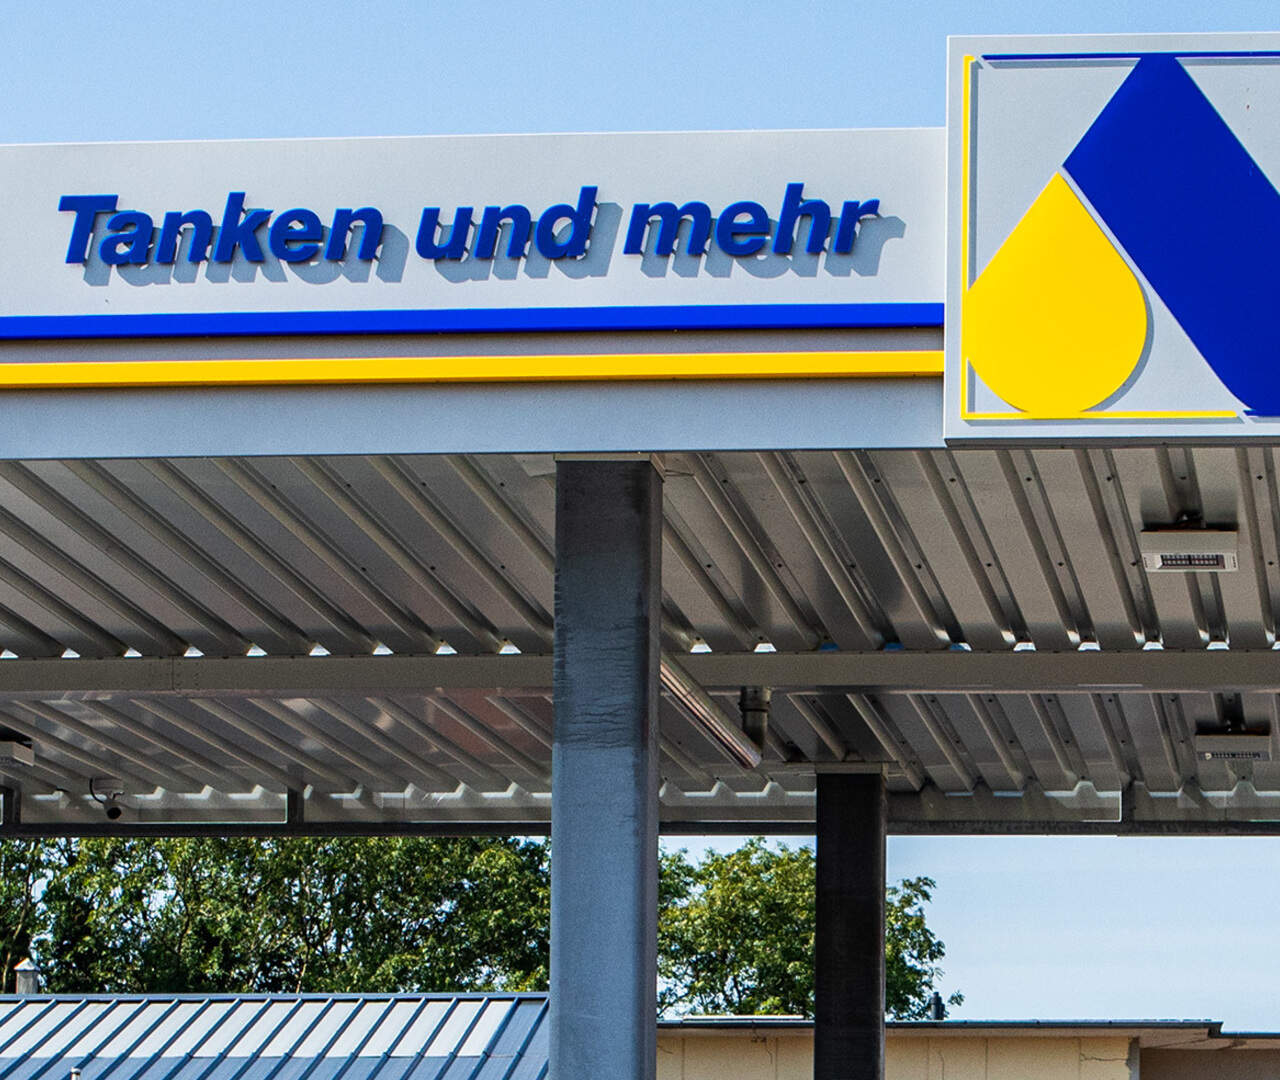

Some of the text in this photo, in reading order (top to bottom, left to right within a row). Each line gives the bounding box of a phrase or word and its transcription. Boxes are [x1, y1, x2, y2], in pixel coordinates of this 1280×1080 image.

[58, 182, 880, 265] Tanken und mehr
